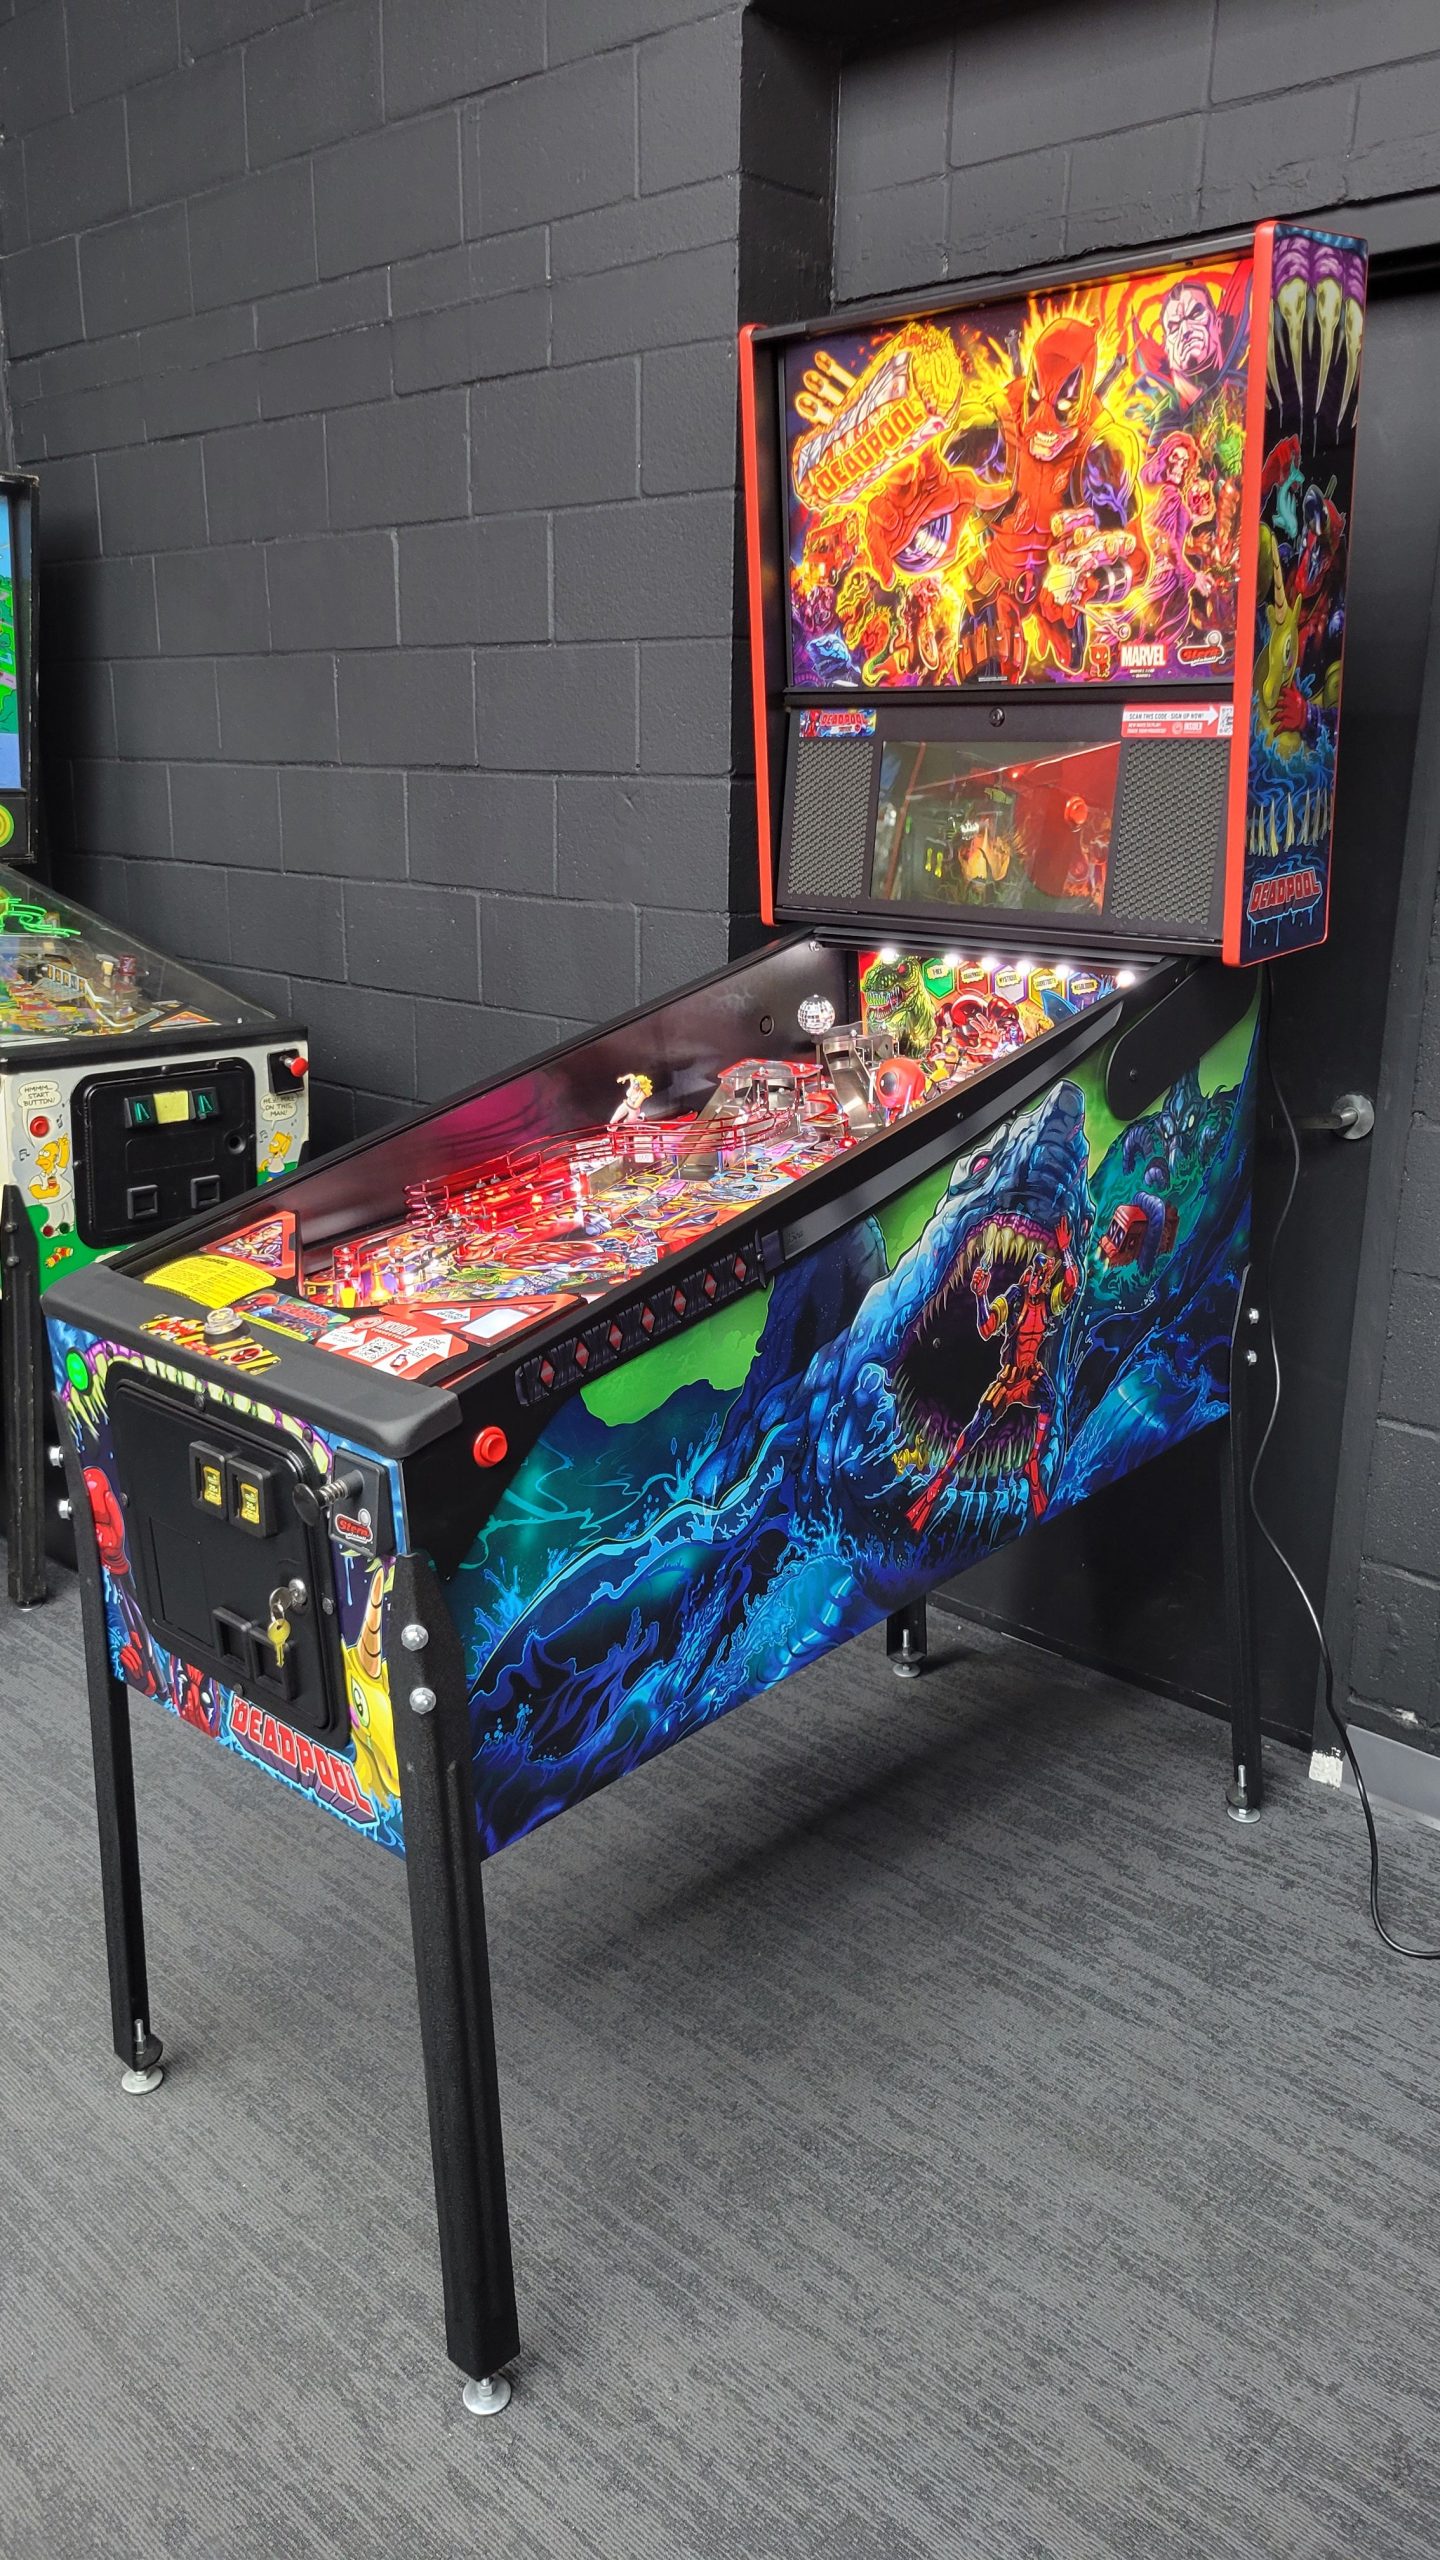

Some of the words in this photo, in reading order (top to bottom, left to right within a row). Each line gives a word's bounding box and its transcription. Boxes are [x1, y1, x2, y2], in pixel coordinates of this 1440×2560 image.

[815, 399, 928, 498] DEADPOOL
[1121, 645, 1166, 667] MARVEL
[1248, 870, 1321, 912] DEADPOOL
[23, 1098, 55, 1106] BUTTON!
[340, 1519, 369, 1537] Stern
[231, 1695, 375, 1818] DEADPOOL
